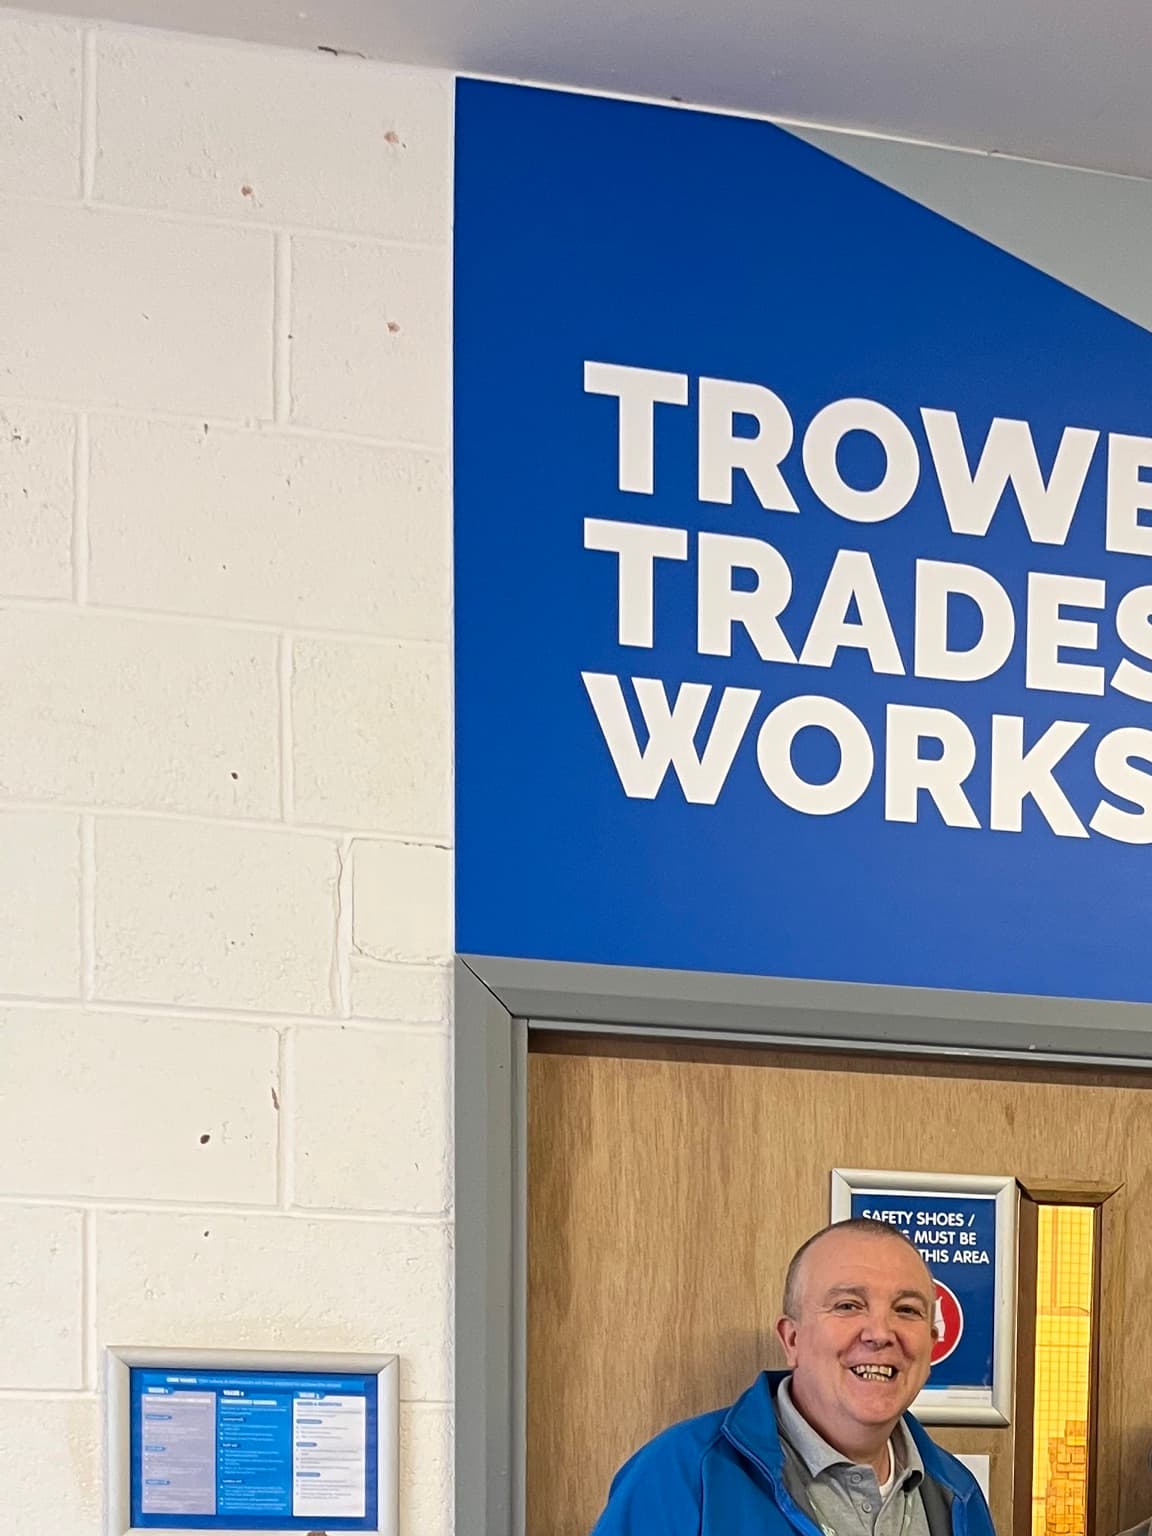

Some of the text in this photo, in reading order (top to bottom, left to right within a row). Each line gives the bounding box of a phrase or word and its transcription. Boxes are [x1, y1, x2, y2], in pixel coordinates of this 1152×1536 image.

[862, 1209, 914, 1225] SAFETY
[916, 1211, 965, 1227] SHOES
[914, 1230, 956, 1245] MUST
[960, 1232, 977, 1246] BE
[919, 1249, 990, 1264] THIS AREA
